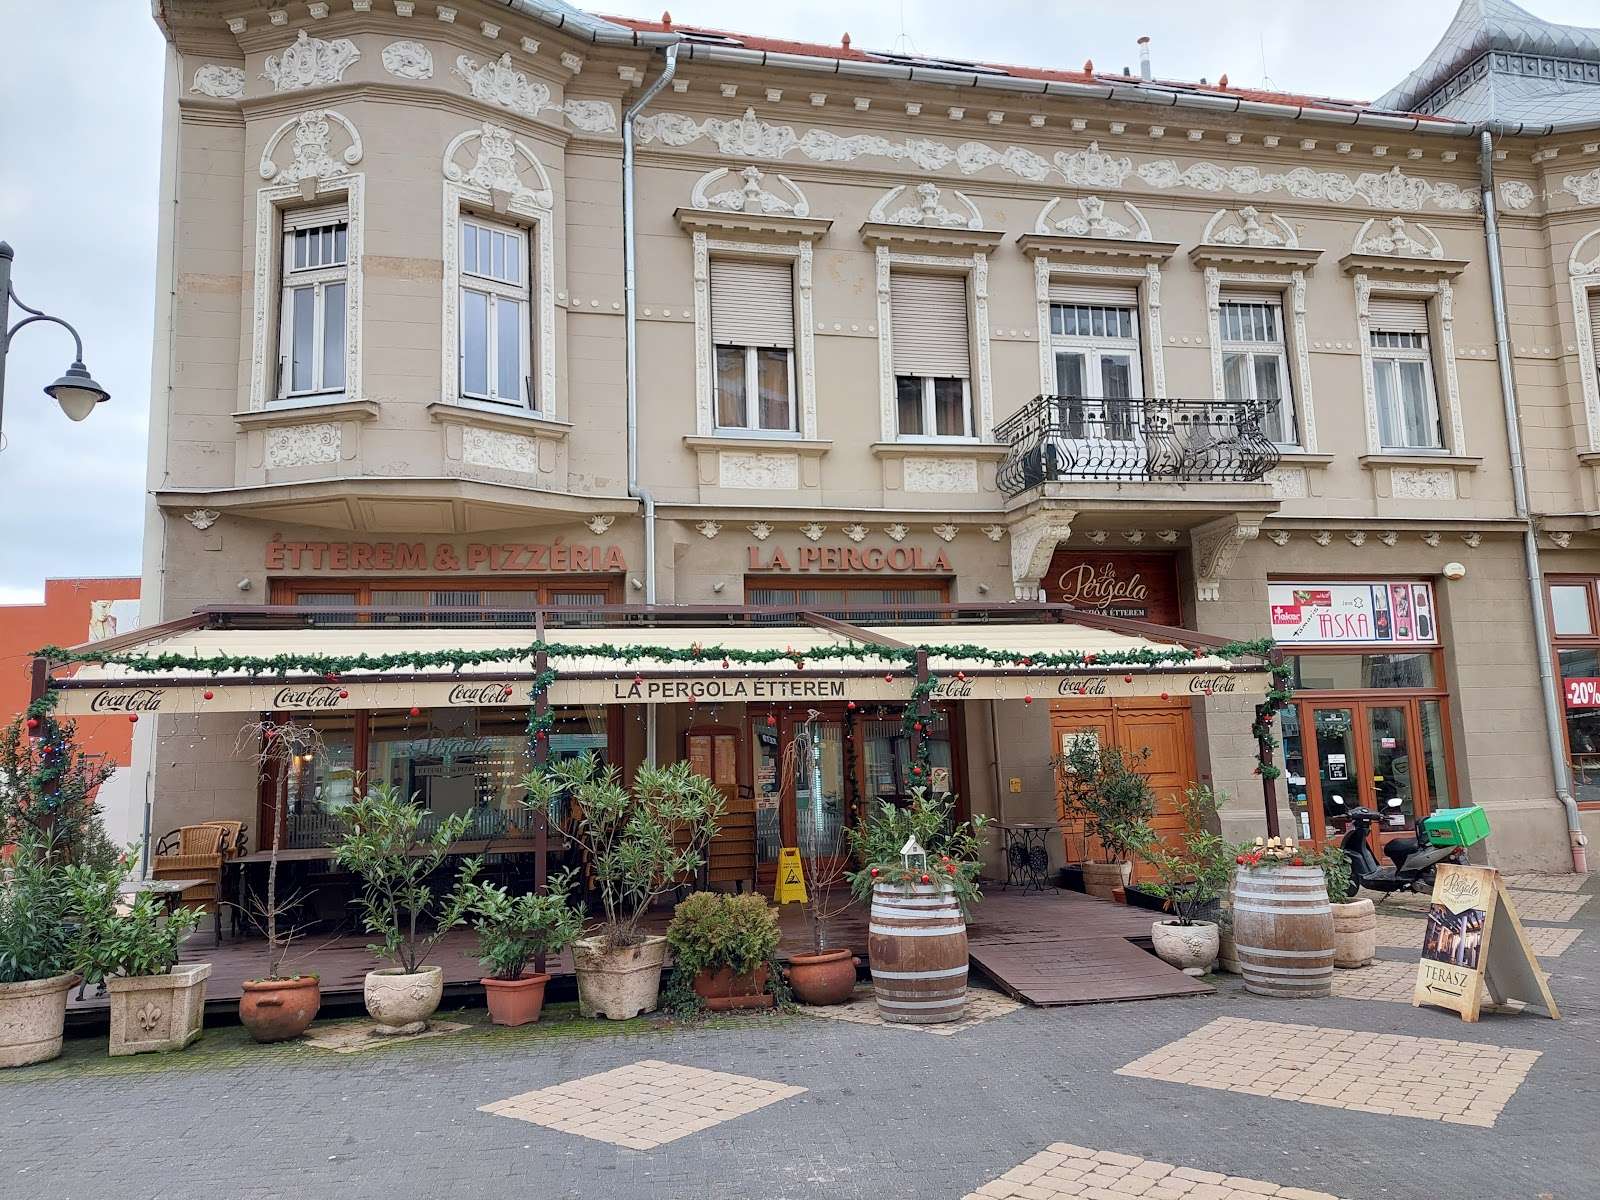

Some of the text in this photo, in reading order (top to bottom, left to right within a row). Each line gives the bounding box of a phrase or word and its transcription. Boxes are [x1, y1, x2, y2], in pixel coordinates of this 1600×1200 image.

[265, 533, 629, 571] ÉTTEREM & PIZZÉRIA
[747, 546, 954, 572] LA PERGOLA
[1098, 562, 1116, 582] La
[1059, 562, 1148, 609] Pergola
[1110, 607, 1145, 616] ÉTTEREM
[1317, 609, 1369, 638] TÁSKA
[615, 678, 845, 699] LA PERGOLA ÉTTEREM
[1567, 682, 1600, 705] -20%
[1443, 872, 1480, 899] Pergola
[1425, 964, 1469, 988] TERASZ
